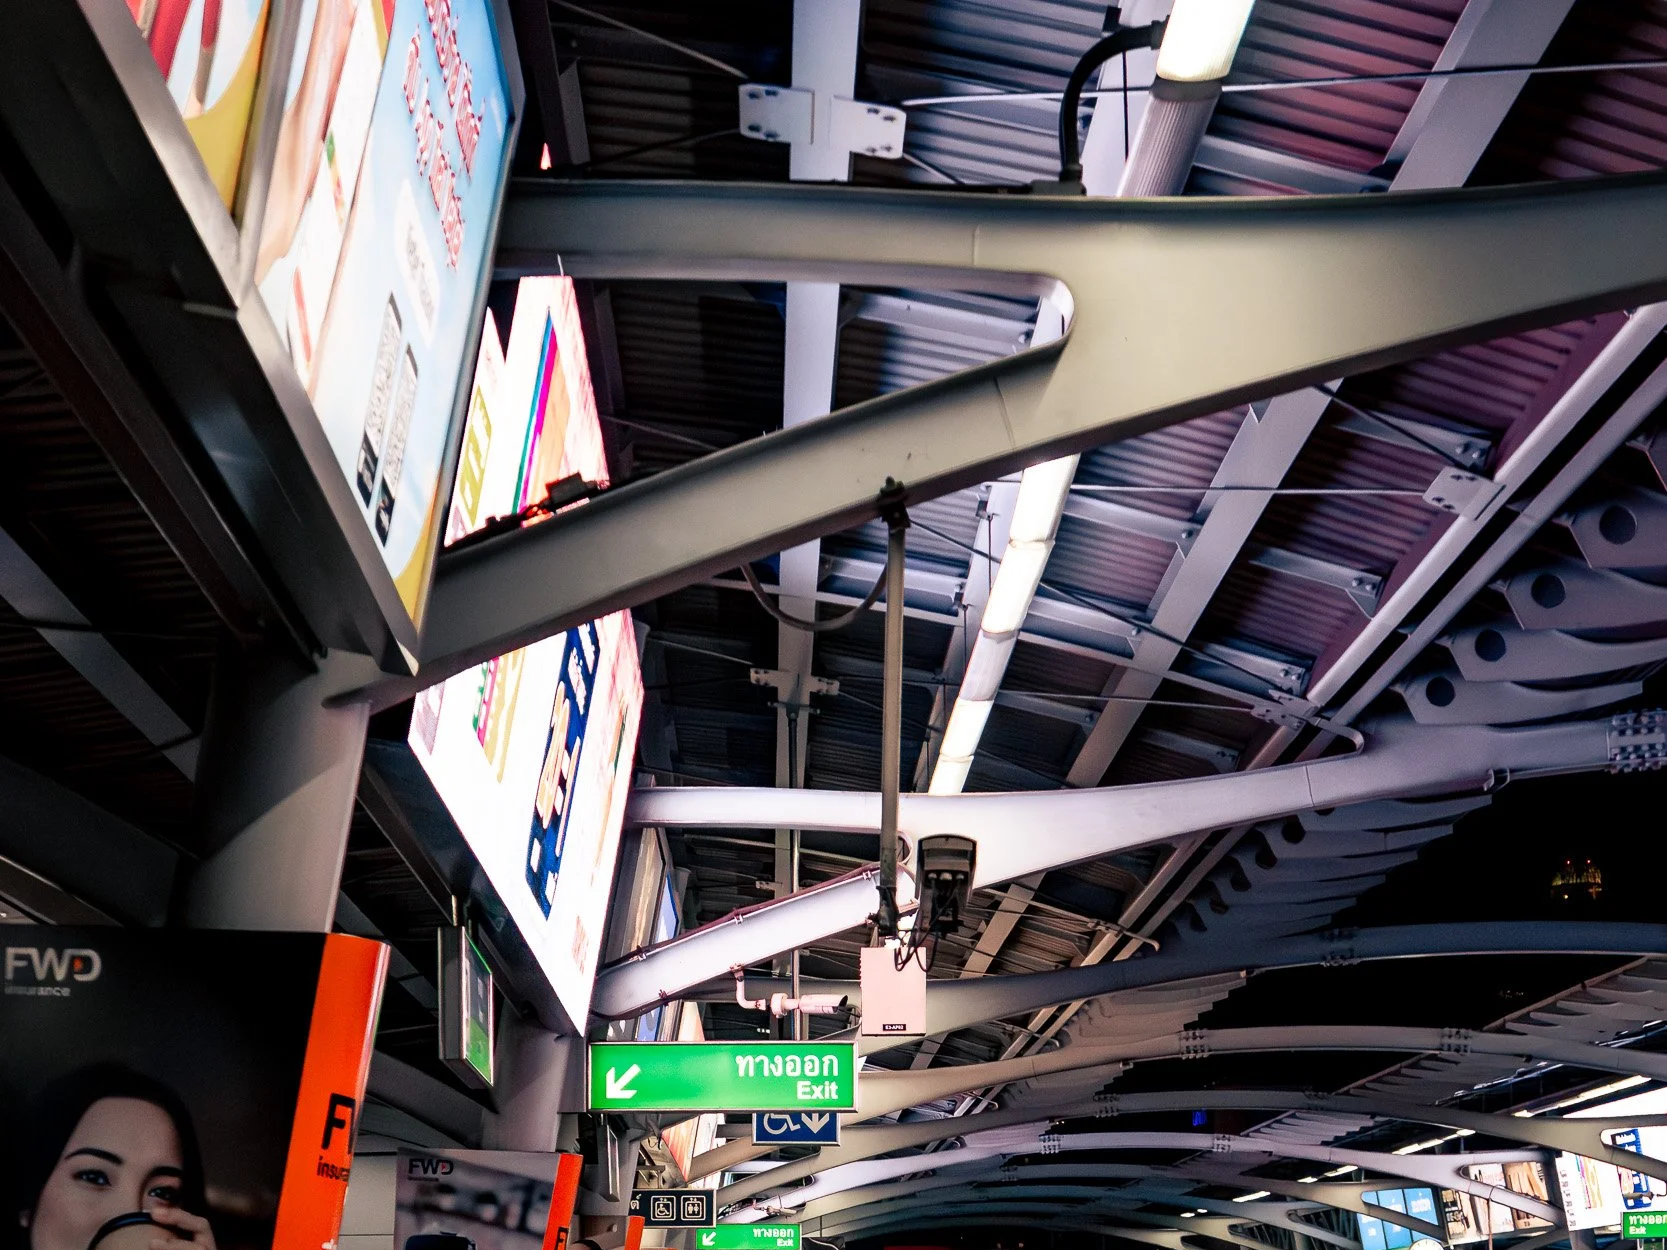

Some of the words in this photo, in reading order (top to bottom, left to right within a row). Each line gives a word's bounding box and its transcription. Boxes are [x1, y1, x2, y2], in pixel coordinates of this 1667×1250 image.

[5, 947, 101, 982] FWD
[735, 1054, 839, 1077] ทางออก
[797, 1080, 839, 1100] Exit
[321, 1092, 356, 1155] F
[408, 1158, 454, 1175] FWD
[752, 1228, 794, 1238] ทางออก
[1628, 1226, 1647, 1235] Exit
[776, 1238, 794, 1247] Exit
